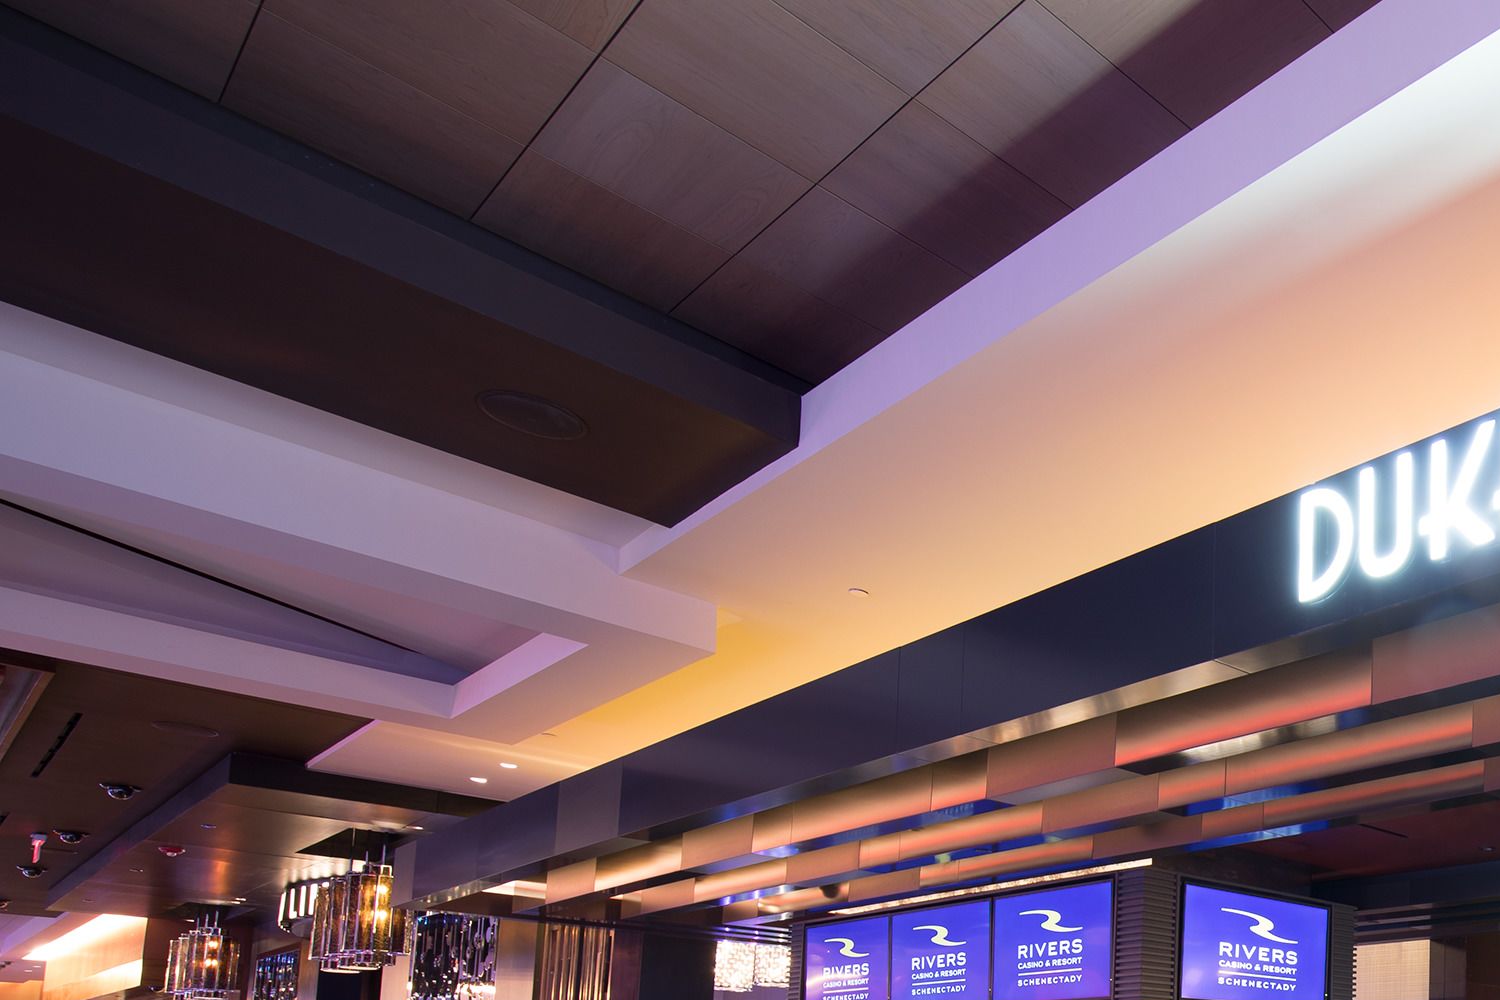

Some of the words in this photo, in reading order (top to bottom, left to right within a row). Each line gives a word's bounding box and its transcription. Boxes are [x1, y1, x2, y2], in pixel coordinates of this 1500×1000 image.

[1017, 938, 1083, 960] RIVERS
[1219, 941, 1298, 965] RIVERS
[911, 952, 967, 971] RIVERS
[1017, 960, 1044, 970] CASINO
[1052, 957, 1083, 966] RESORT
[1218, 959, 1252, 970] CASINO
[1254, 963, 1261, 971] &
[1262, 964, 1297, 975] RESORT
[911, 971, 934, 980] CASINO
[940, 968, 967, 977] RESORT
[1017, 974, 1083, 987] SCHENECTADY
[911, 984, 967, 996] SCHENECTADY
[1217, 977, 1297, 992] SCHENECTADY
